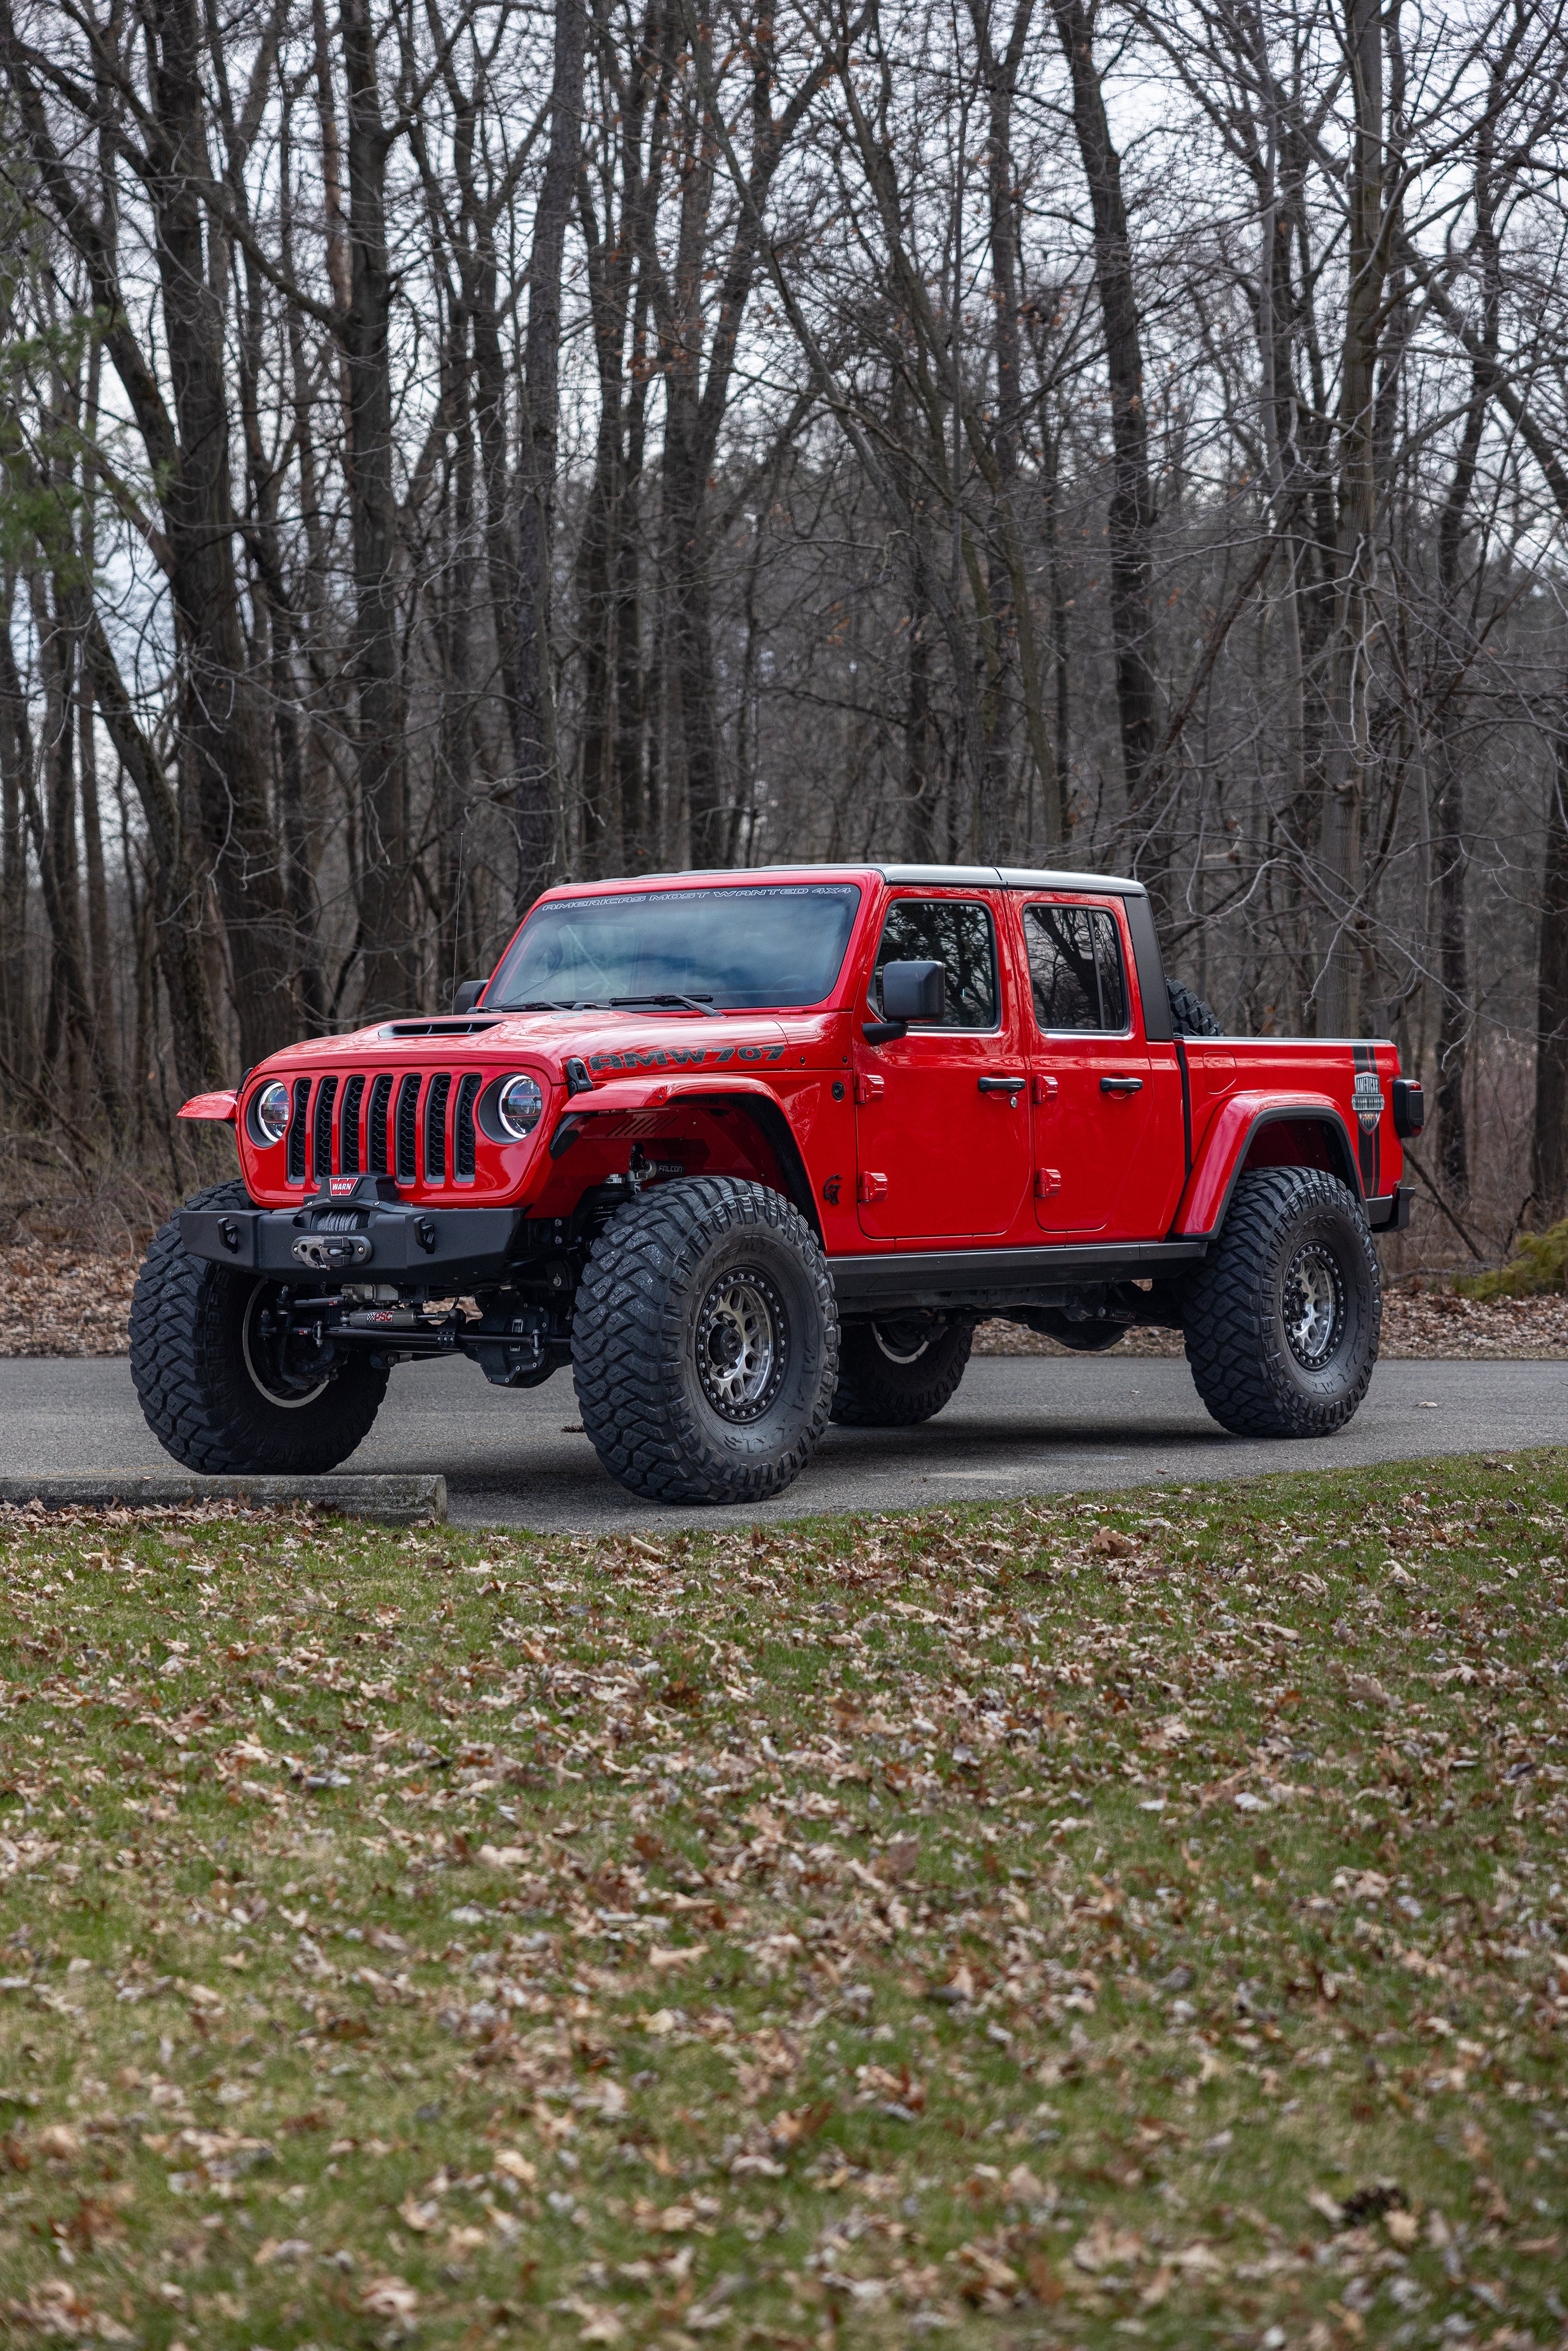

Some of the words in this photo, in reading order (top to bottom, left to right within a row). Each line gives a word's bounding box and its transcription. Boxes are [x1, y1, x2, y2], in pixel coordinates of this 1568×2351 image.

[542, 895, 646, 911] AMERICAS
[649, 891, 710, 902] MOST
[713, 888, 809, 897] WANTED
[588, 1048, 707, 1071] AMW
[711, 1045, 785, 1062] 707
[1357, 1077, 1377, 1094] AMERICAS
[374, 1311, 393, 1322] PSC
